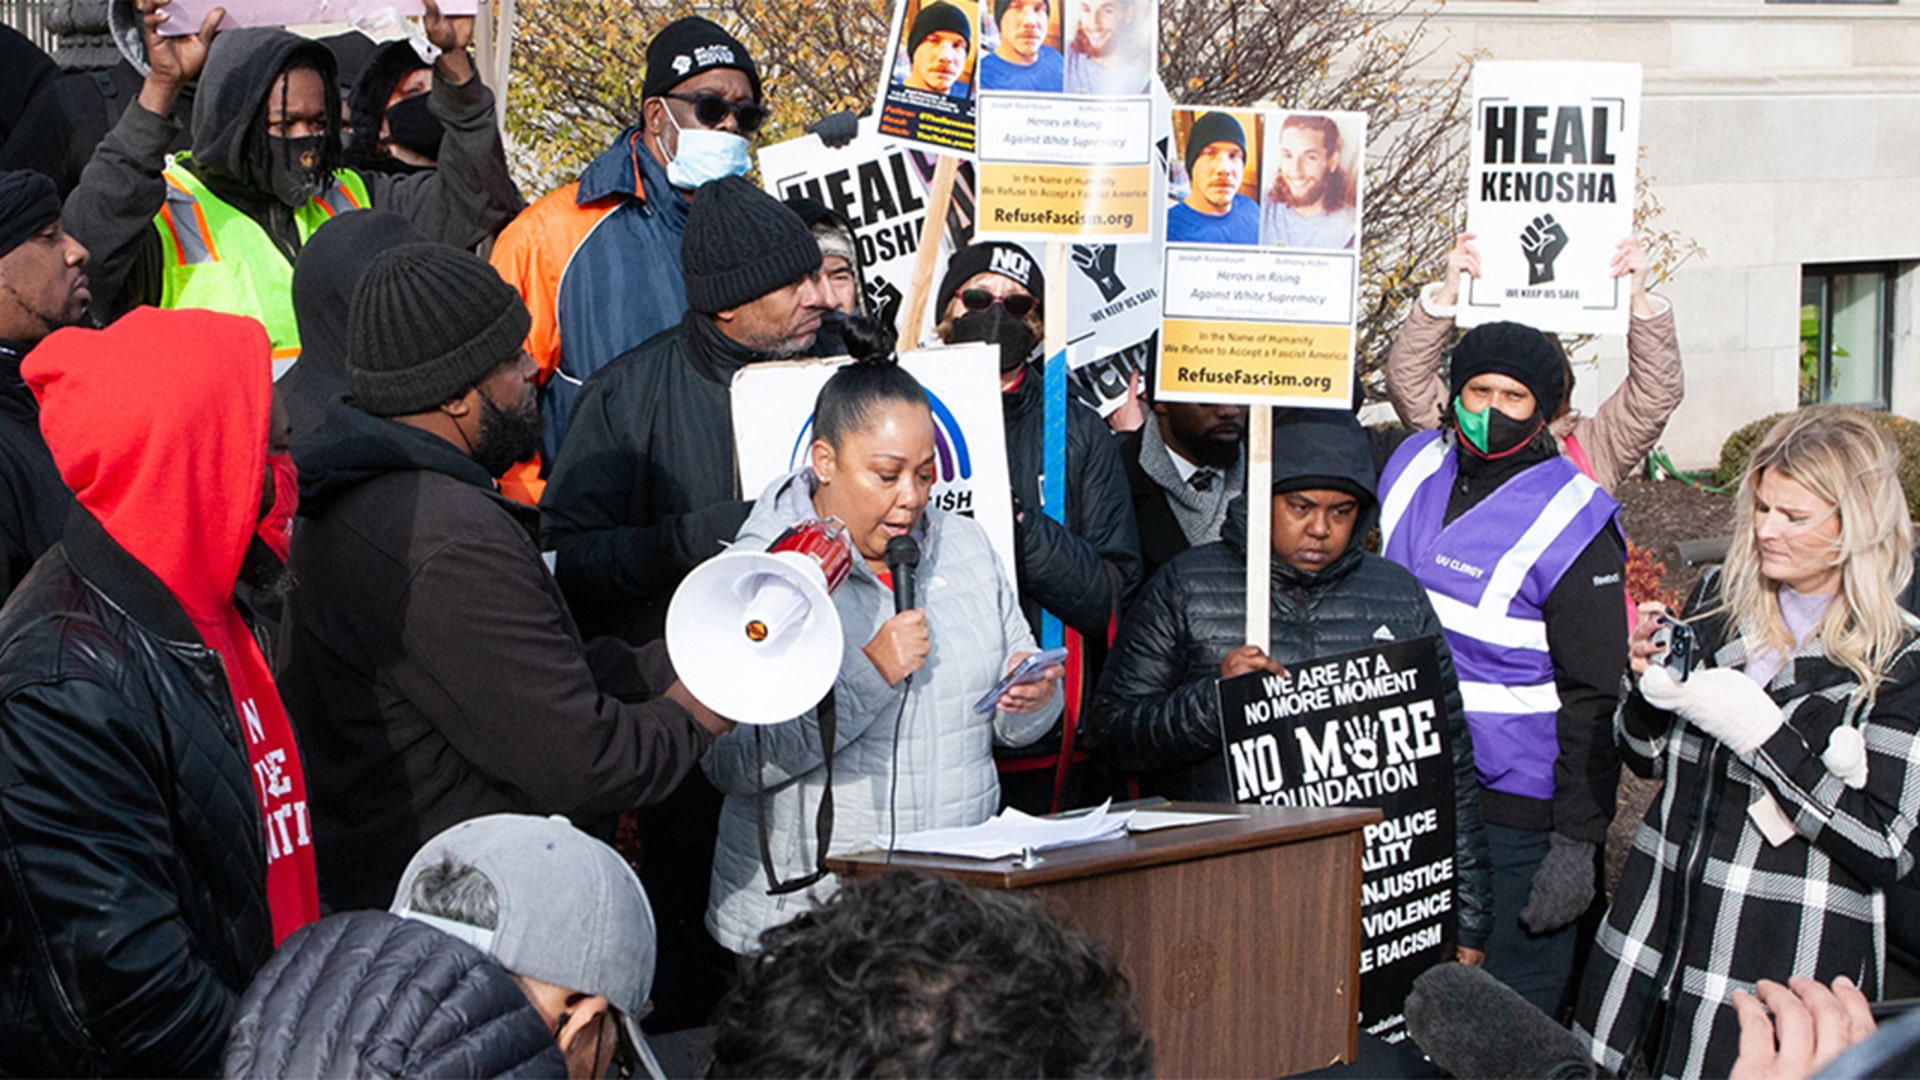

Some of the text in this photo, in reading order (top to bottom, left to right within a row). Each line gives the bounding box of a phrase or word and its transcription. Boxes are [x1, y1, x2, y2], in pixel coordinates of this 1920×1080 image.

[1027, 116, 1060, 127] Heroes
[1062, 116, 1071, 127] in
[1003, 133, 1040, 148] Against
[1042, 135, 1070, 146] White
[1483, 105, 1616, 165] HEAL
[1021, 174, 1036, 184] the
[1039, 176, 1066, 186] Name
[1480, 171, 1617, 203] KENOSHA
[981, 187, 995, 196] We
[997, 188, 1028, 198] Refuse
[1040, 189, 1069, 200] Accept
[990, 247, 1031, 280] NO!
[1216, 270, 1301, 286] Heroes in Rising
[1190, 288, 1327, 305] Against White Supremacy
[1521, 289, 1542, 299] KEEP
[1199, 332, 1314, 346] In the Name of Humanity
[1164, 344, 1179, 354] We
[1181, 344, 1215, 355] Refuse
[1217, 346, 1227, 355] to
[1229, 346, 1262, 359] Accept
[1272, 348, 1307, 359] Fascist
[1308, 349, 1348, 361] America
[1177, 367, 1331, 392] RefuseFascism.org
[1435, 554, 1485, 578] UU CLERGY
[1263, 653, 1390, 698] WE ARE AT A
[1244, 669, 1418, 726] NO MORE MOMENT
[1230, 733, 1284, 801] NO
[1363, 808, 1438, 848] POLICE
[1360, 857, 1453, 908] NJUSTICE
[1363, 889, 1452, 938] VIOLENCE
[1359, 923, 1442, 974] E RACISM
